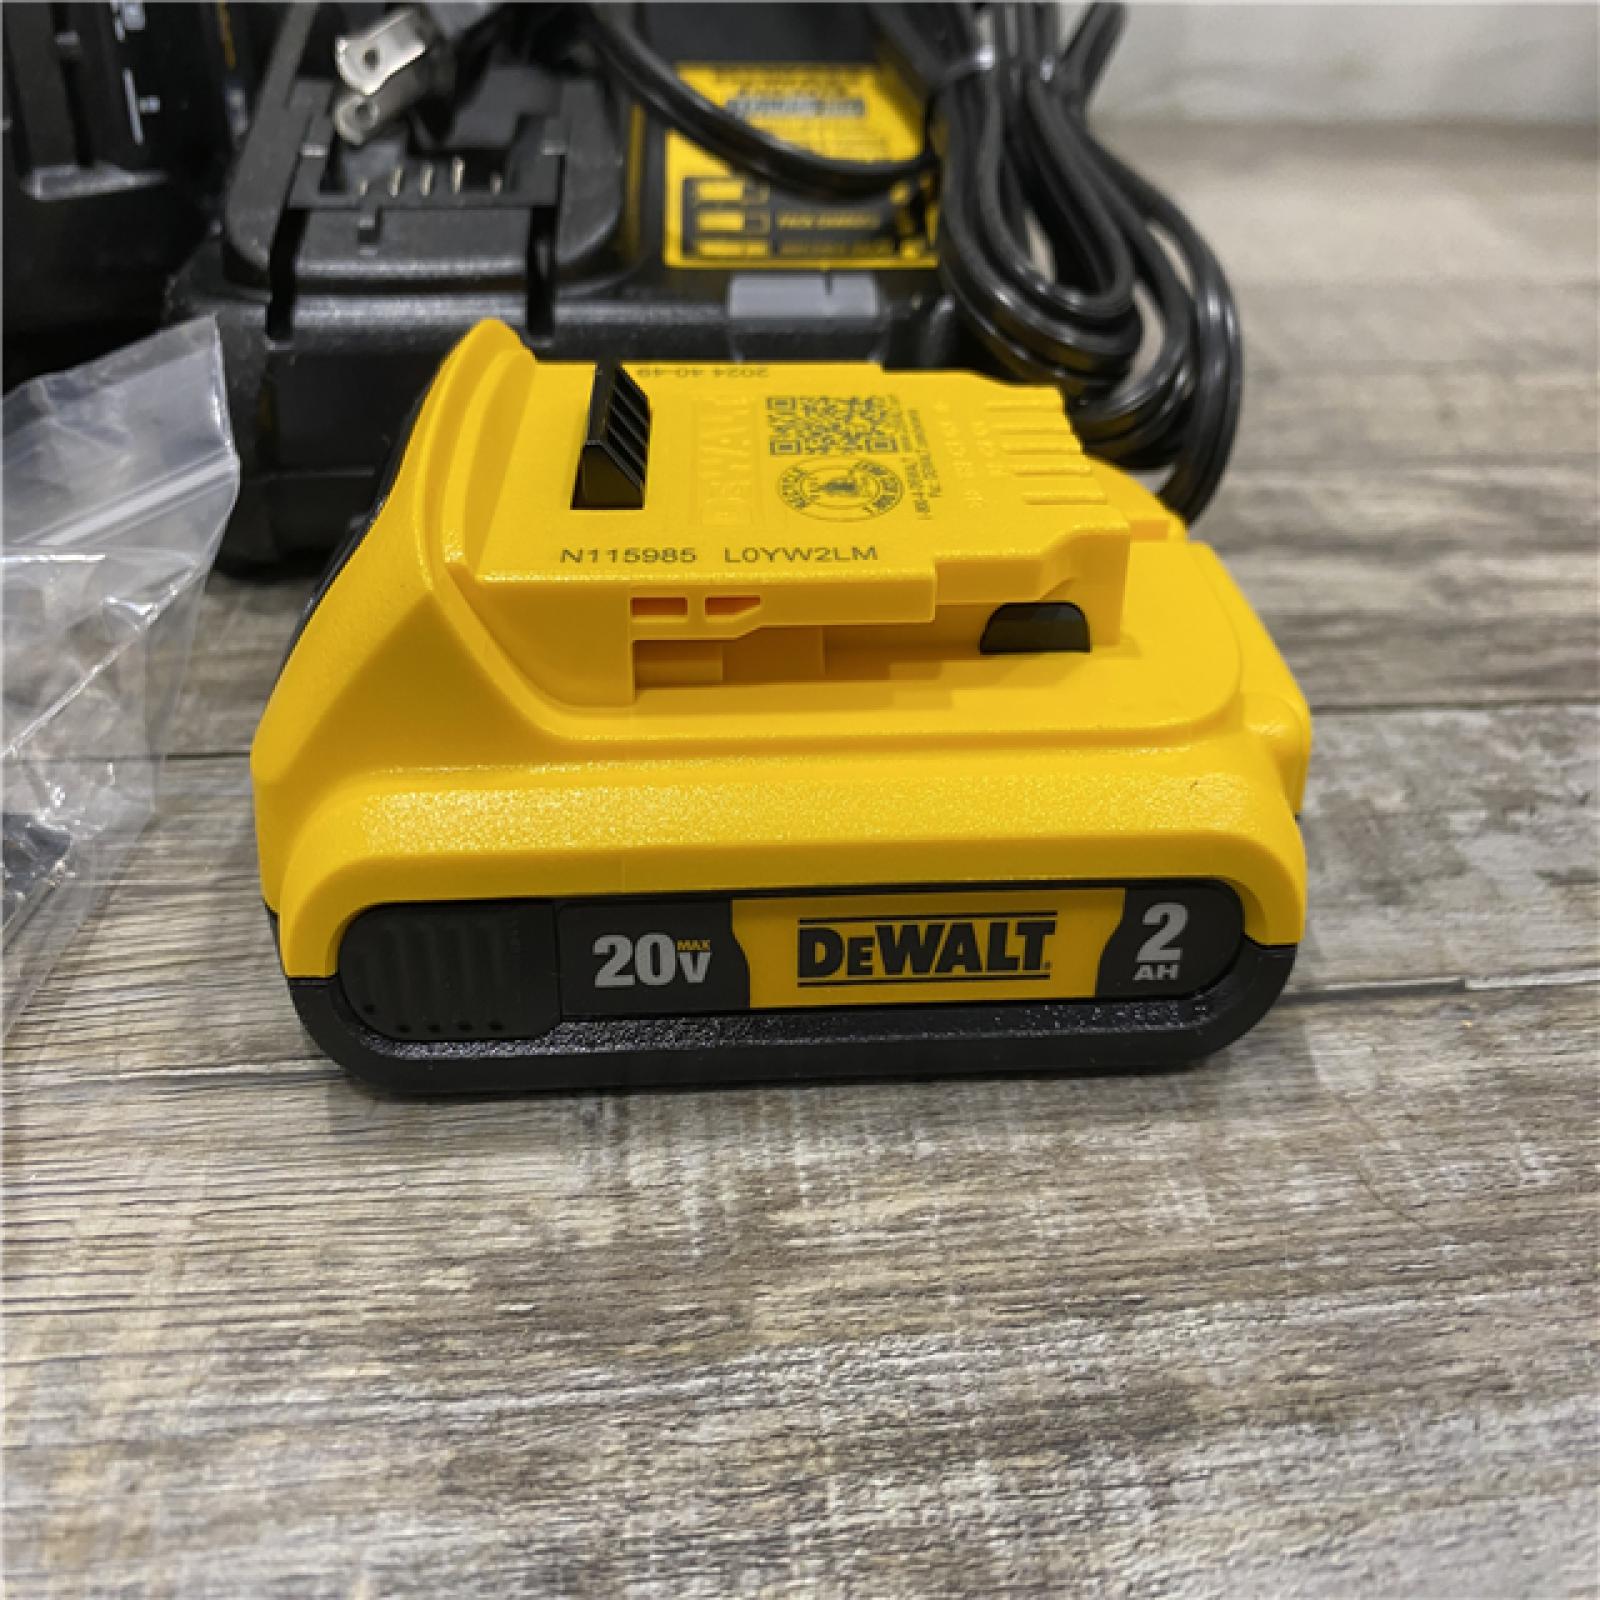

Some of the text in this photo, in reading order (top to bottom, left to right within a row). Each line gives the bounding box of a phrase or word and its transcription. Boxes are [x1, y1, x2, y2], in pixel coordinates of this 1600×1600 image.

[559, 548, 697, 564] N115985
[1136, 902, 1189, 963] 2
[677, 939, 711, 951] MAX
